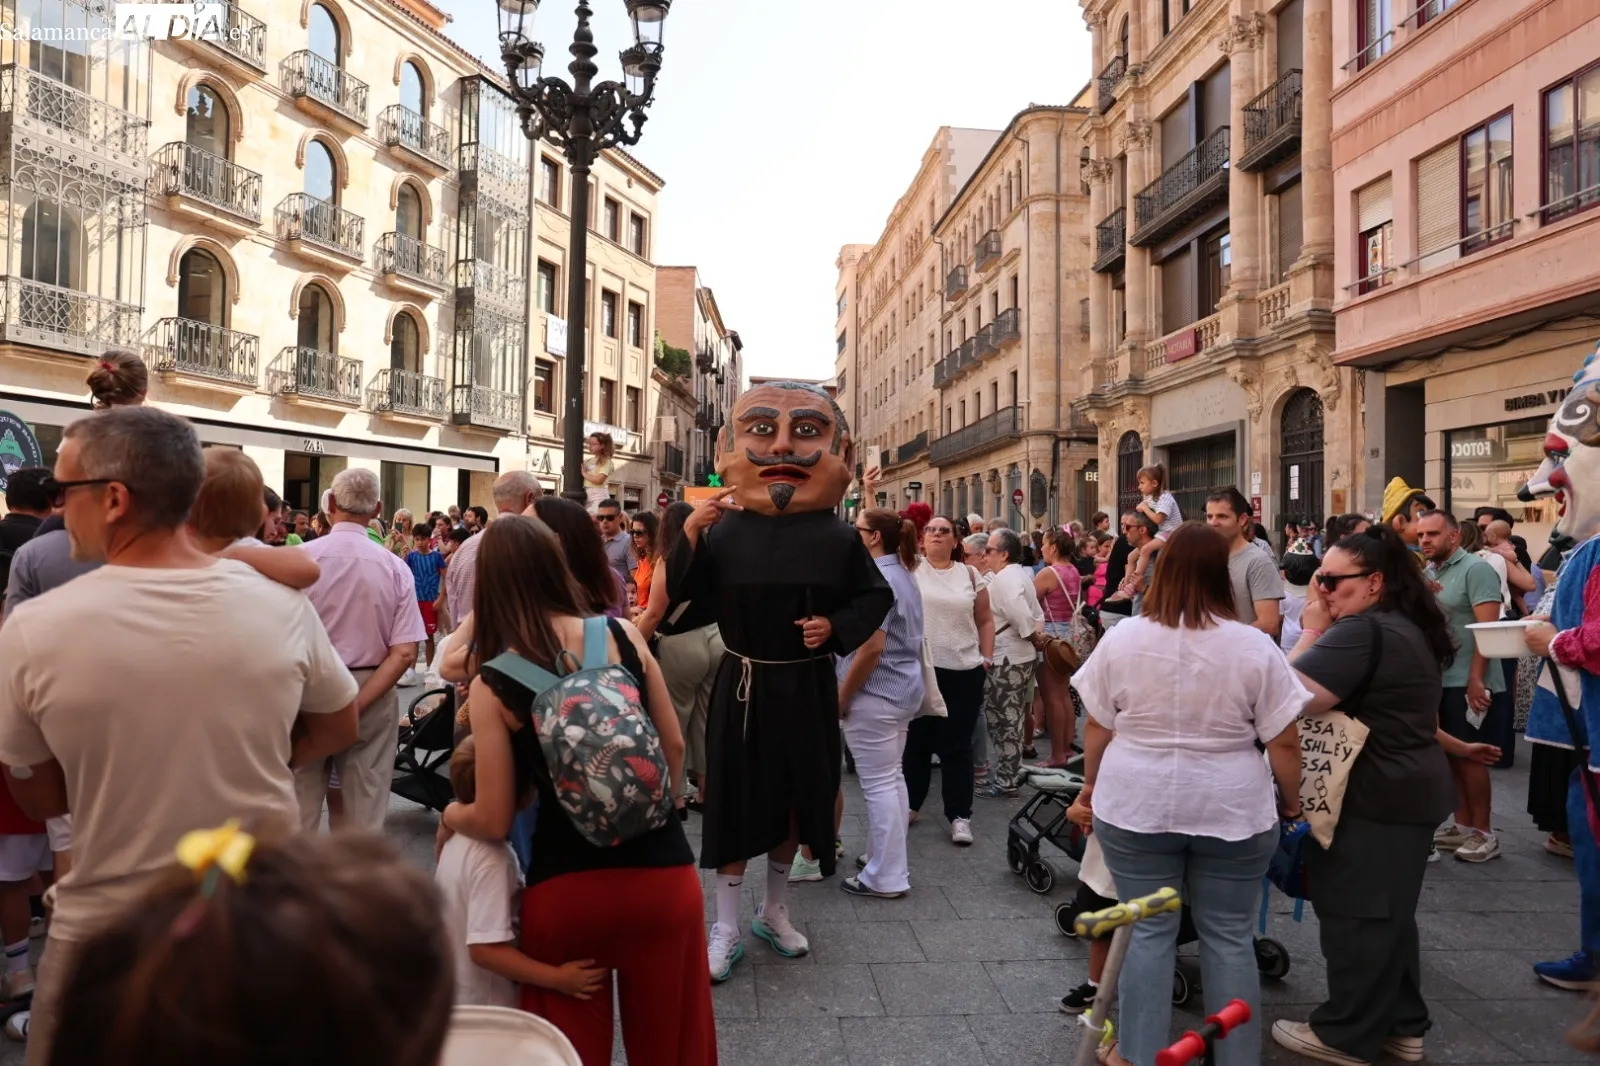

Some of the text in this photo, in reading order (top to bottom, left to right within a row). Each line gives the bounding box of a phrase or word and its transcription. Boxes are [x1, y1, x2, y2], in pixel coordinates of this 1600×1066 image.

[1504, 392, 1547, 411] BIMBA
[1546, 389, 1558, 403] Y
[303, 438, 324, 454] ZARA
